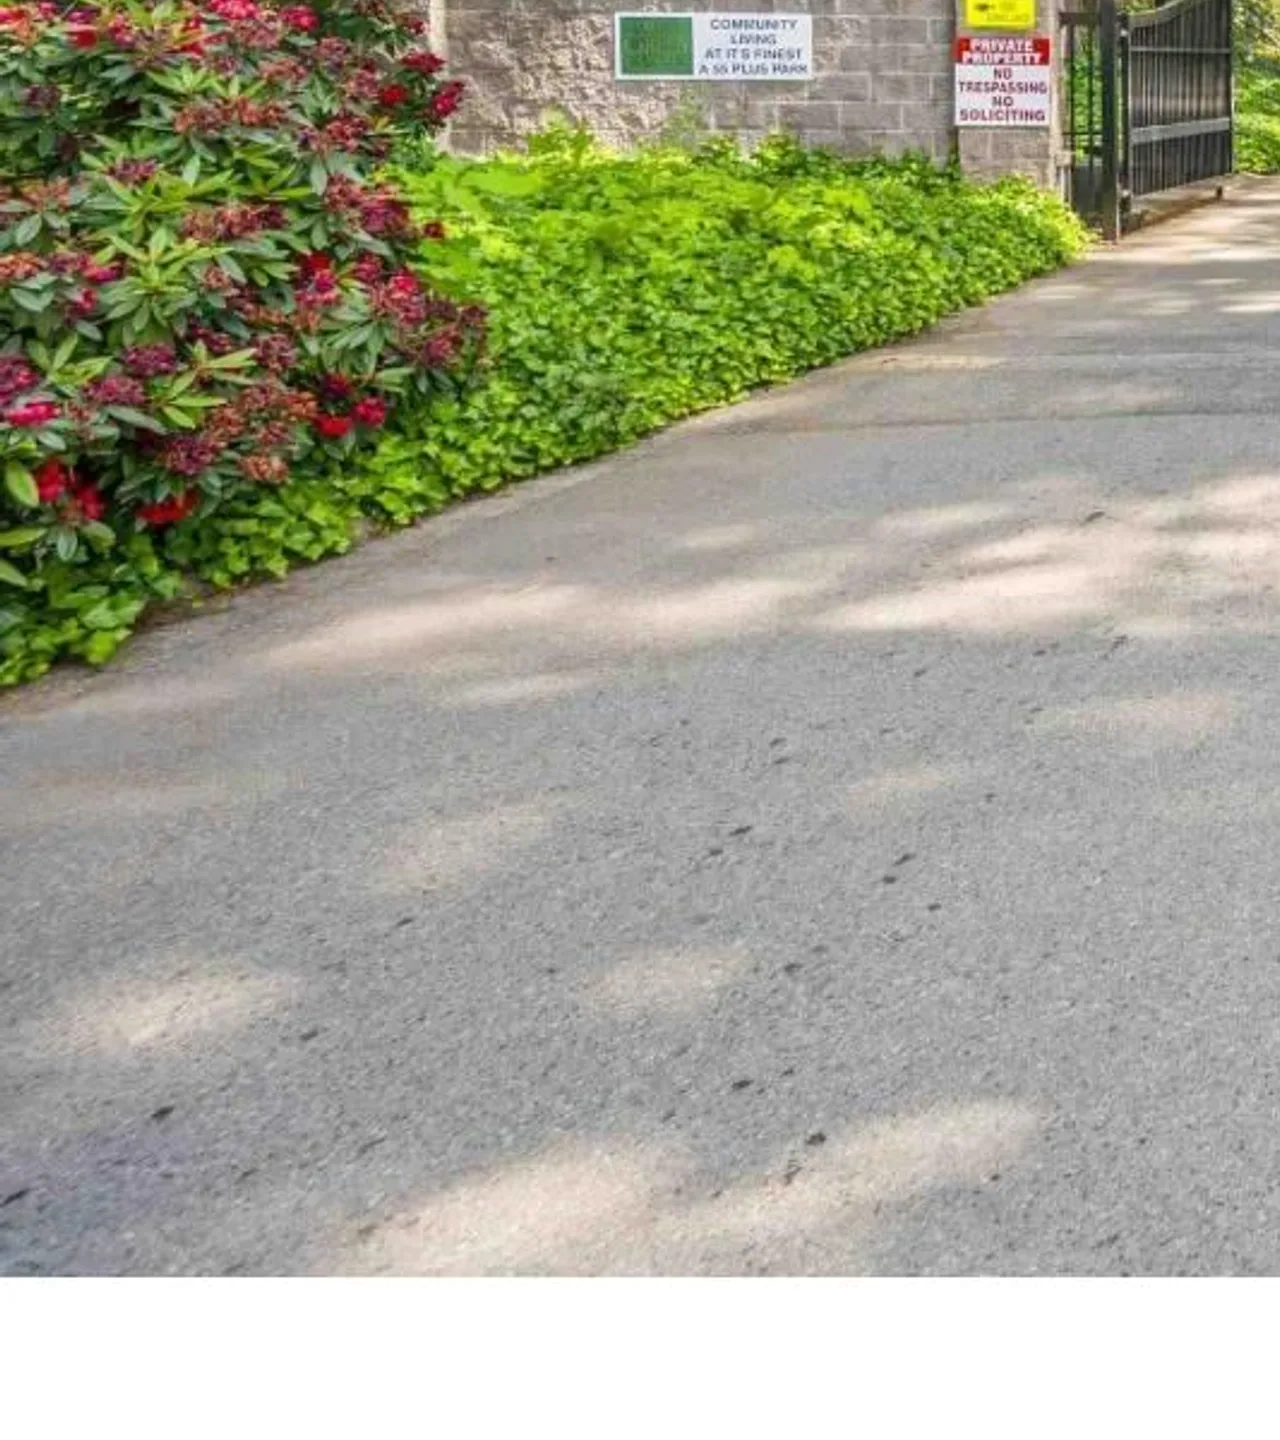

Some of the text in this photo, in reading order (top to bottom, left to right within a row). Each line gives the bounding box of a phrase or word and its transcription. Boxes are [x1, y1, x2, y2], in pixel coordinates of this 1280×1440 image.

[710, 19, 798, 30] COMMUNITY
[729, 33, 777, 45] LIVING
[969, 39, 1034, 53] PRIVATE
[705, 48, 721, 59] AT
[754, 48, 801, 59] FINEST
[962, 52, 1042, 65] PROPERTY
[731, 63, 768, 75] PLUS
[772, 63, 808, 75] PARK
[993, 67, 1012, 79] NO
[958, 81, 1048, 94] TRESPASSING
[992, 95, 1014, 107] NO
[960, 110, 1046, 122] SOLICITING
